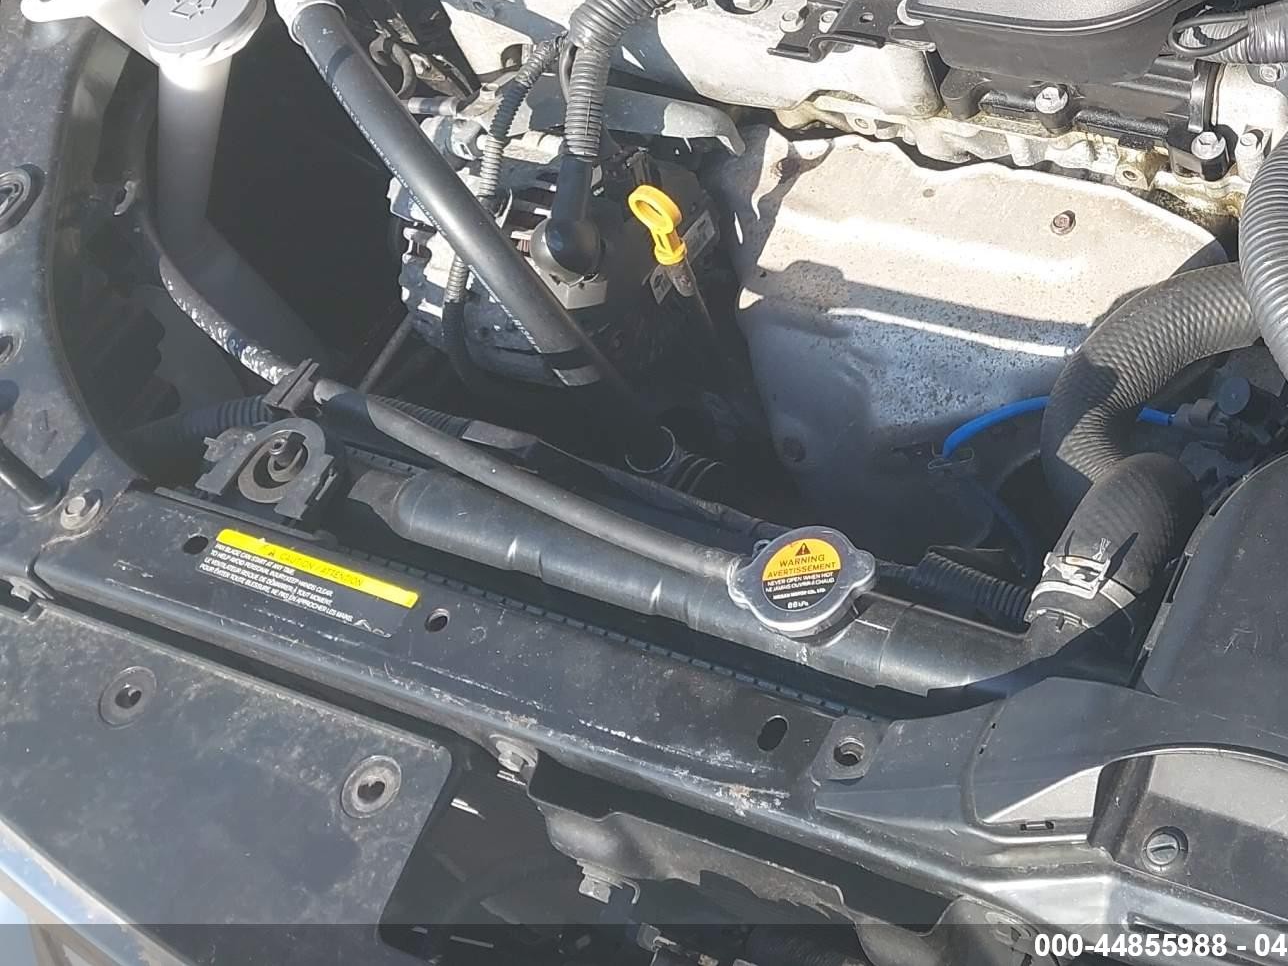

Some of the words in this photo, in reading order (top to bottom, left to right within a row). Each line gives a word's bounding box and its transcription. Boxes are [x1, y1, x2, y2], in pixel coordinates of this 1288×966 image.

[198, 563, 214, 572] POUR
[780, 554, 824, 567] WARNING
[216, 552, 231, 560] HELP
[229, 556, 245, 565] AVOID
[297, 580, 317, 590] HANDS
[277, 552, 315, 570] CAUTION
[318, 566, 363, 586] ATTENTION
[767, 561, 835, 577] AVERTISSEMENT
